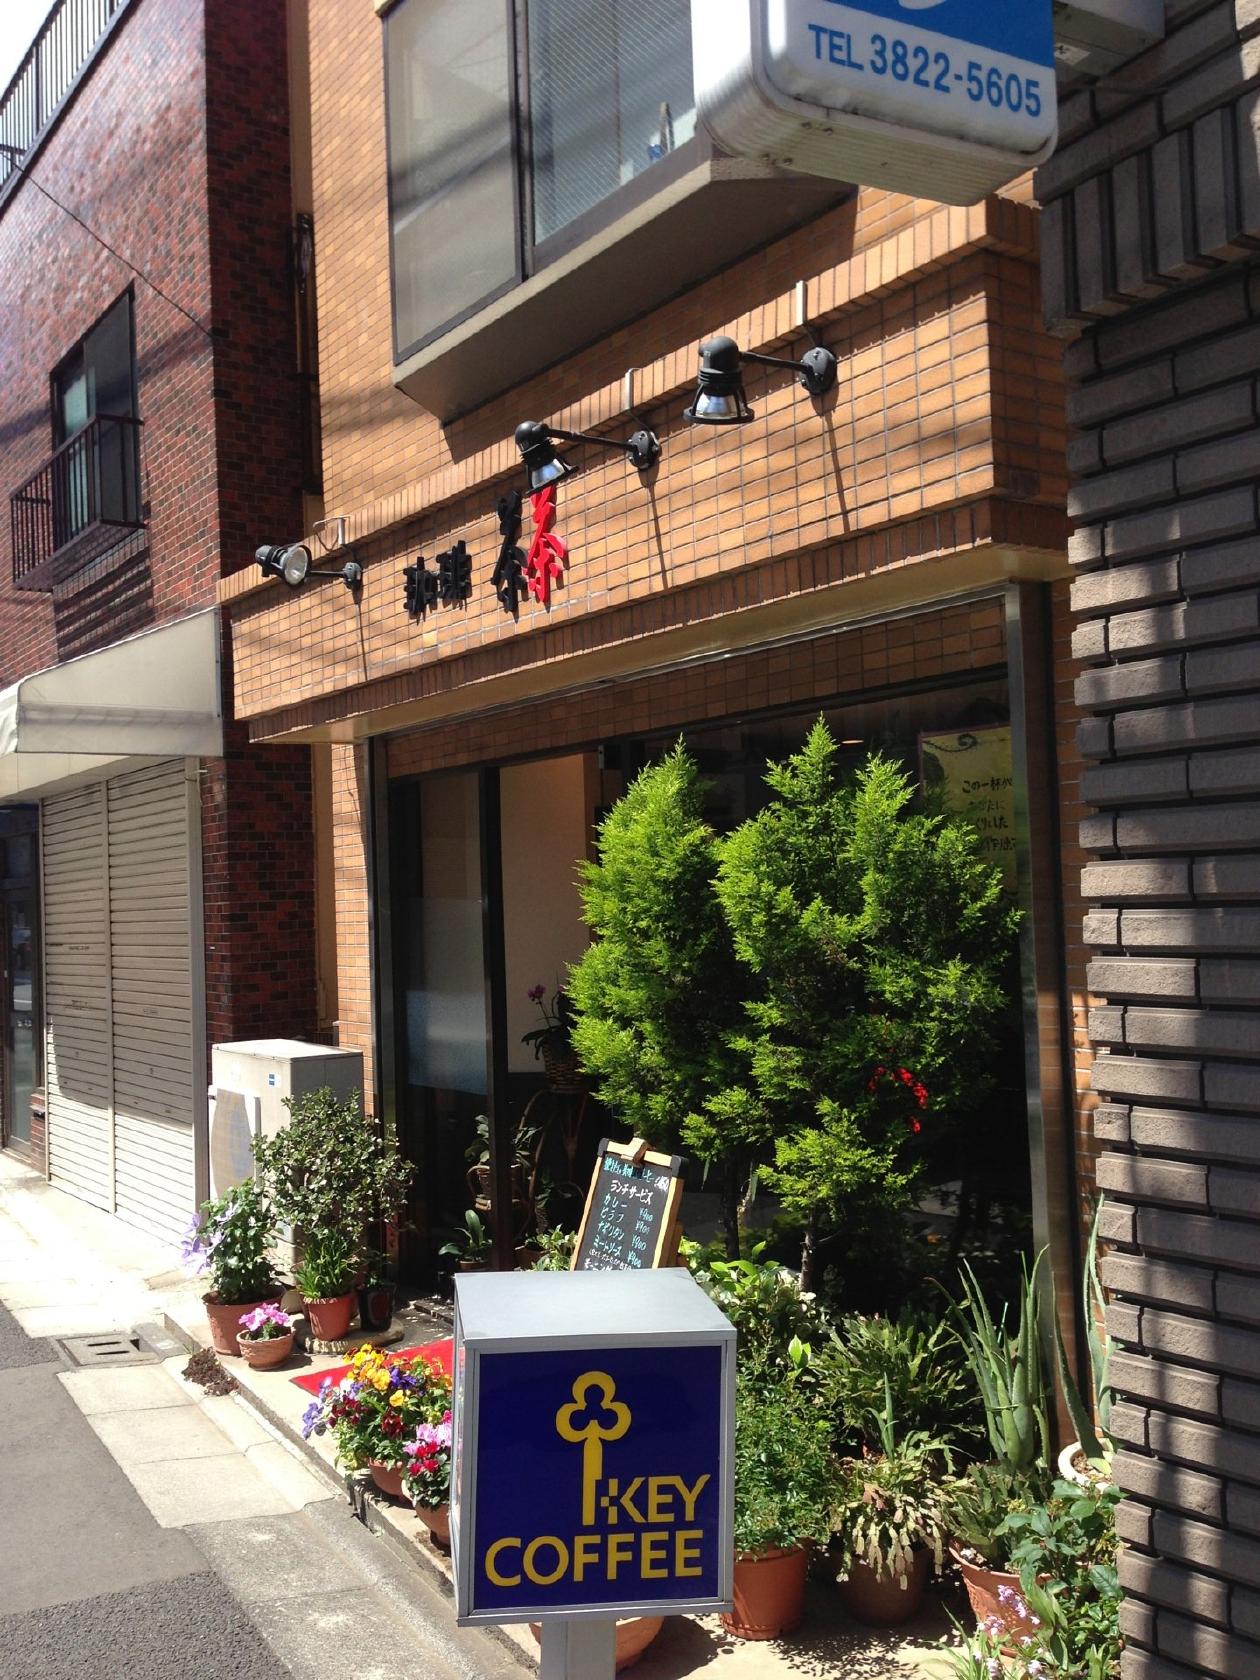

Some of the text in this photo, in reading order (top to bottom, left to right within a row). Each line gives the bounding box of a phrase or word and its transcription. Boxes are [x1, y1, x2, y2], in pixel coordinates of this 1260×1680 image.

[807, 23, 1041, 117] TEL 3822-5605
[604, 1193, 628, 1208] カレー
[610, 1179, 654, 1205] ランチサービス
[600, 1206, 625, 1223] ピラフ
[607, 1474, 711, 1525] KEY
[485, 1529, 704, 1587] COFFEE
